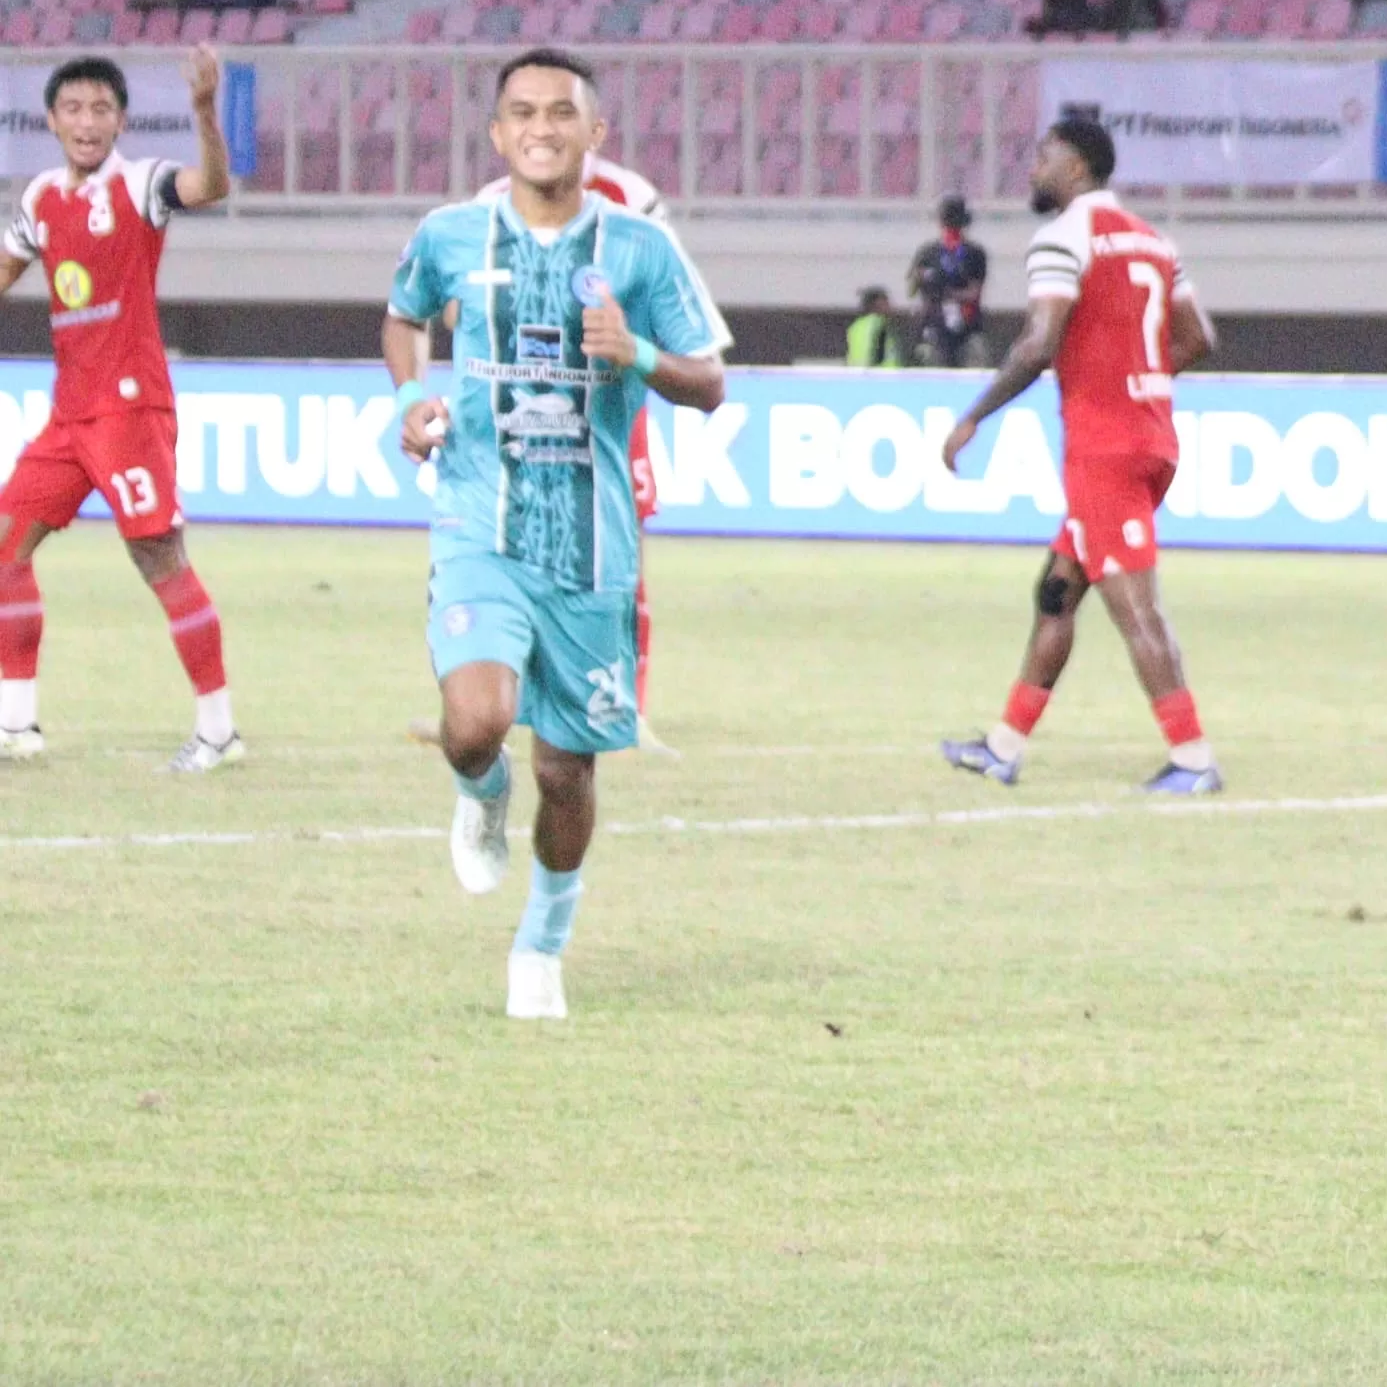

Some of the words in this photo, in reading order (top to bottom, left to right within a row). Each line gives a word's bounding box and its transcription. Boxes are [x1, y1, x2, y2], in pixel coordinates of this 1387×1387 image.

[1128, 261, 1165, 371] 7
[111, 467, 158, 517] 13
[768, 403, 1068, 516] BOLA
